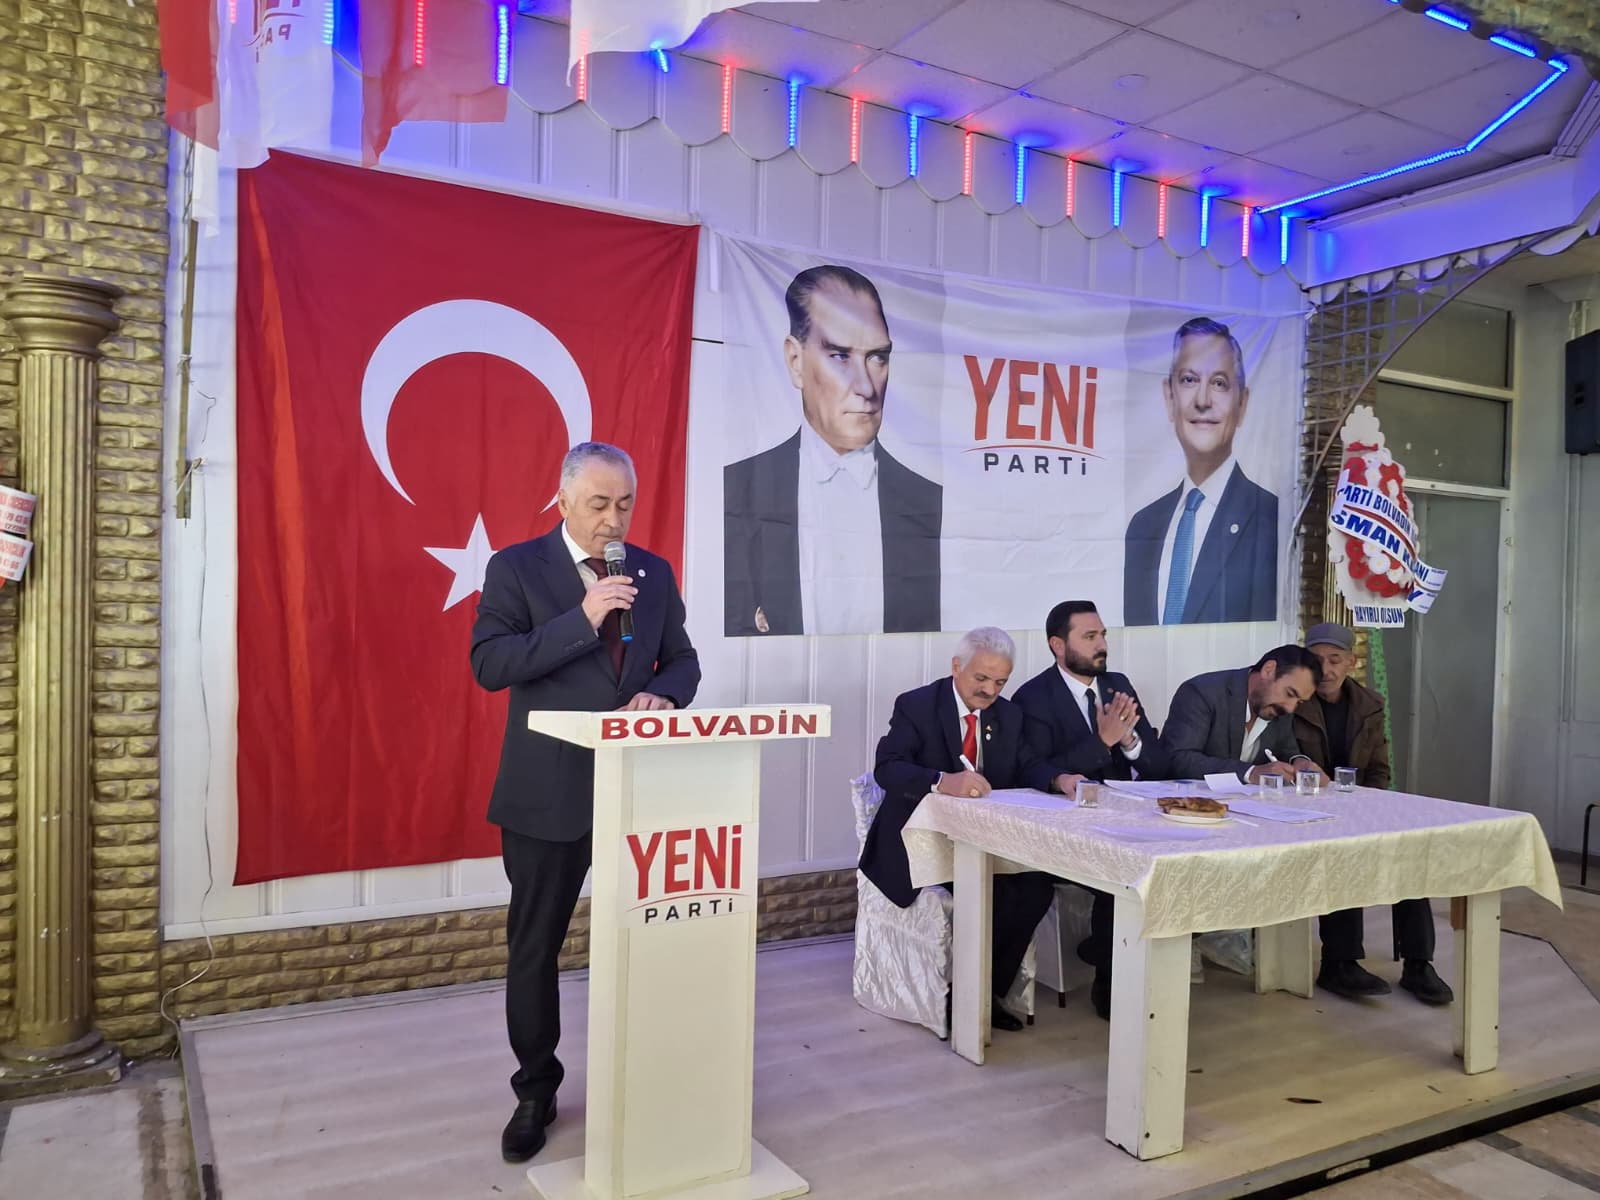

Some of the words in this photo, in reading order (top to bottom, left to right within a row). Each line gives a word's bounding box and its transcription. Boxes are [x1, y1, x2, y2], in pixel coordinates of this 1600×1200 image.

[1337, 485, 1373, 507] ARTİ
[1354, 606, 1380, 623] HAYIRLI
[1380, 607, 1404, 624] OLSUN
[601, 709, 817, 740] BOLVADİN
